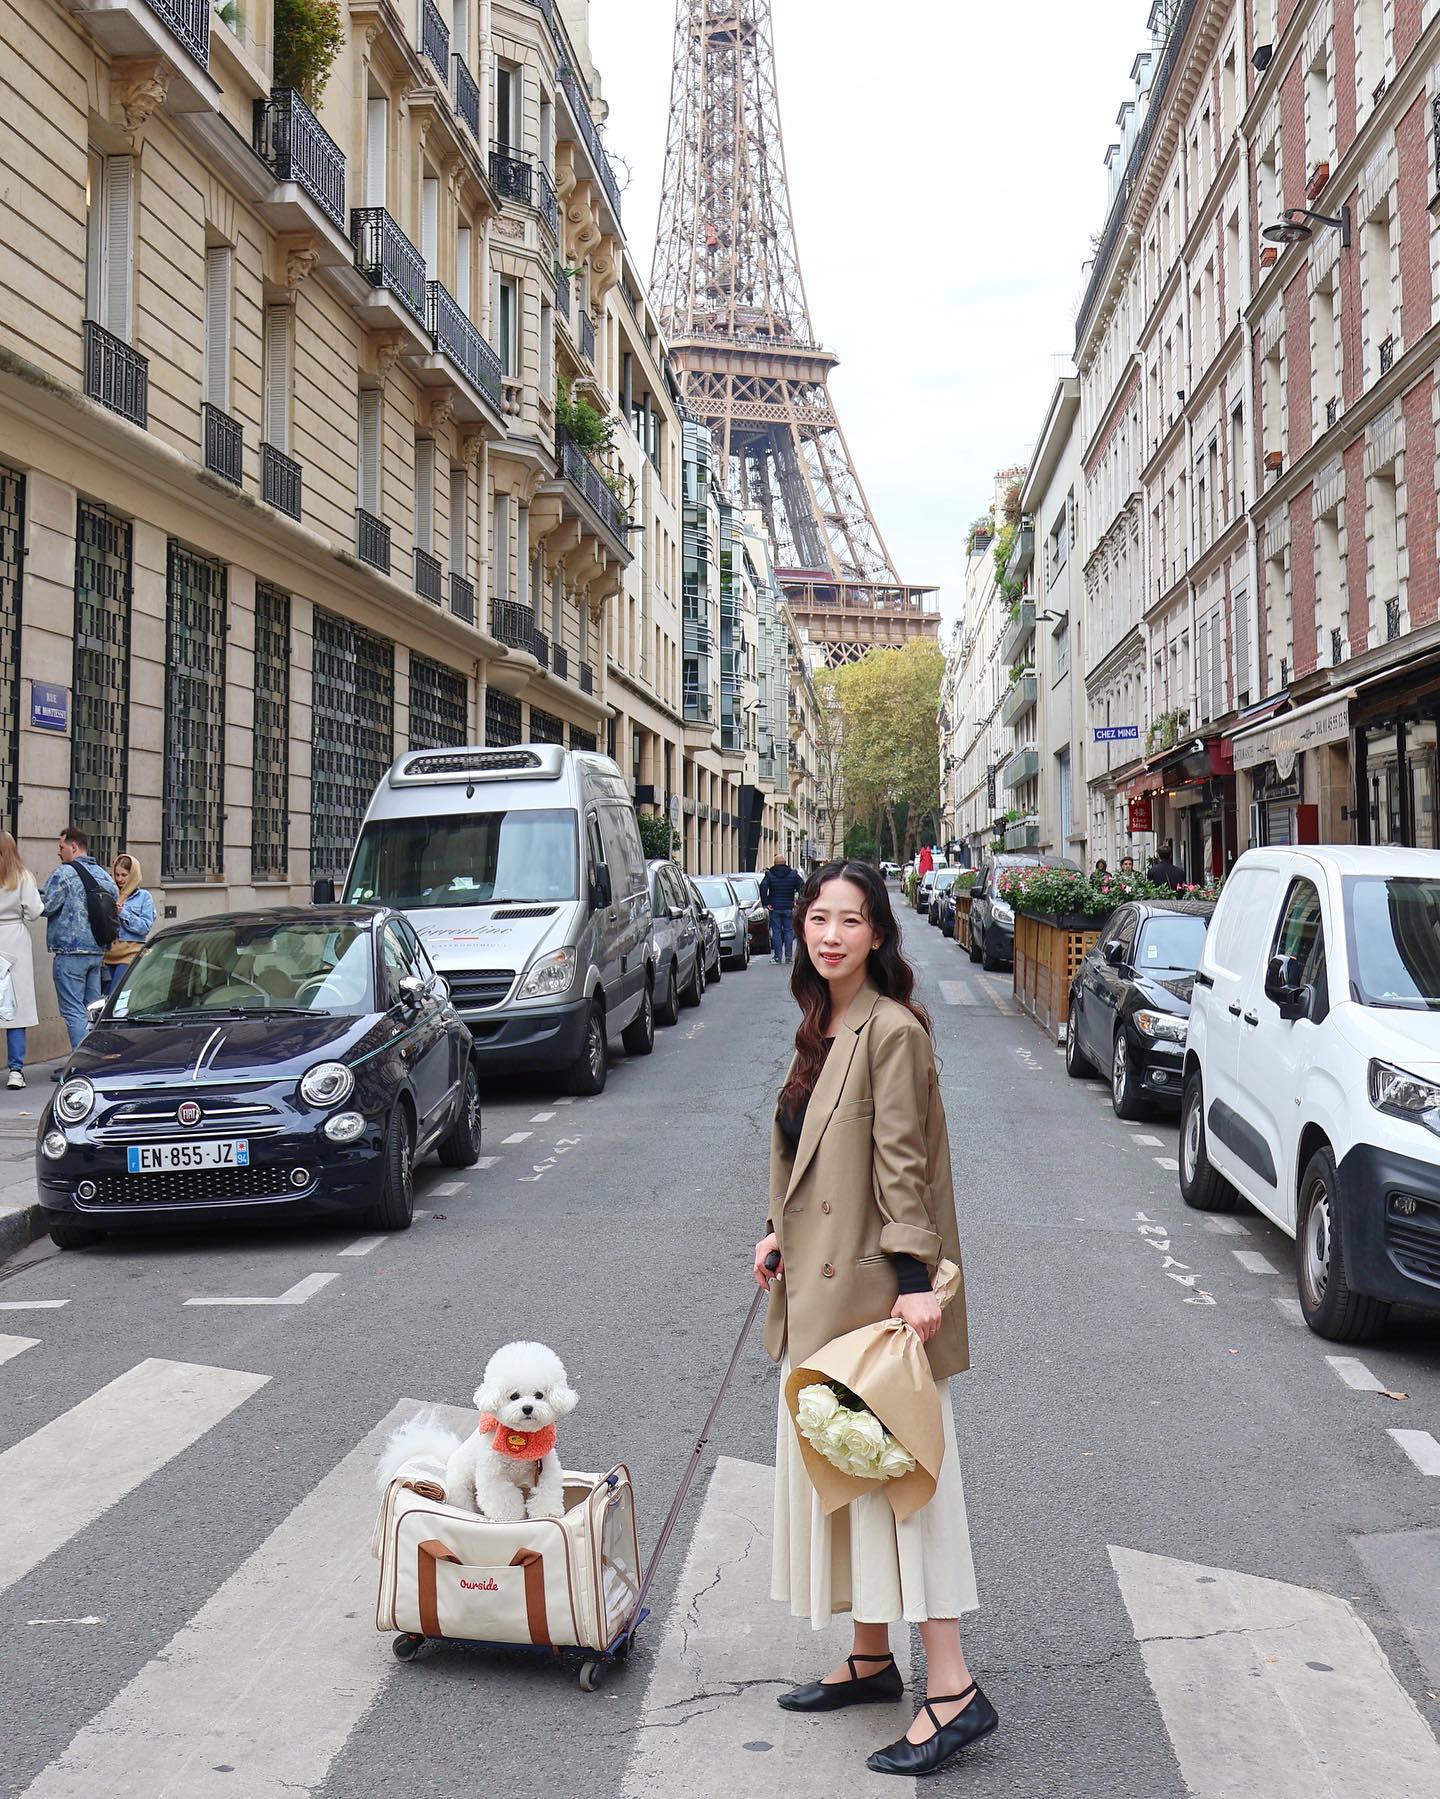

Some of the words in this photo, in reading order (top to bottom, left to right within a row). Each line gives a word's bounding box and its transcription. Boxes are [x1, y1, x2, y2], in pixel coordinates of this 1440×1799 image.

[1096, 729, 1116, 739] CHEZ
[1117, 728, 1137, 738] MING
[182, 1108, 196, 1120] FIAT
[460, 1577, 499, 1591] Ourside
